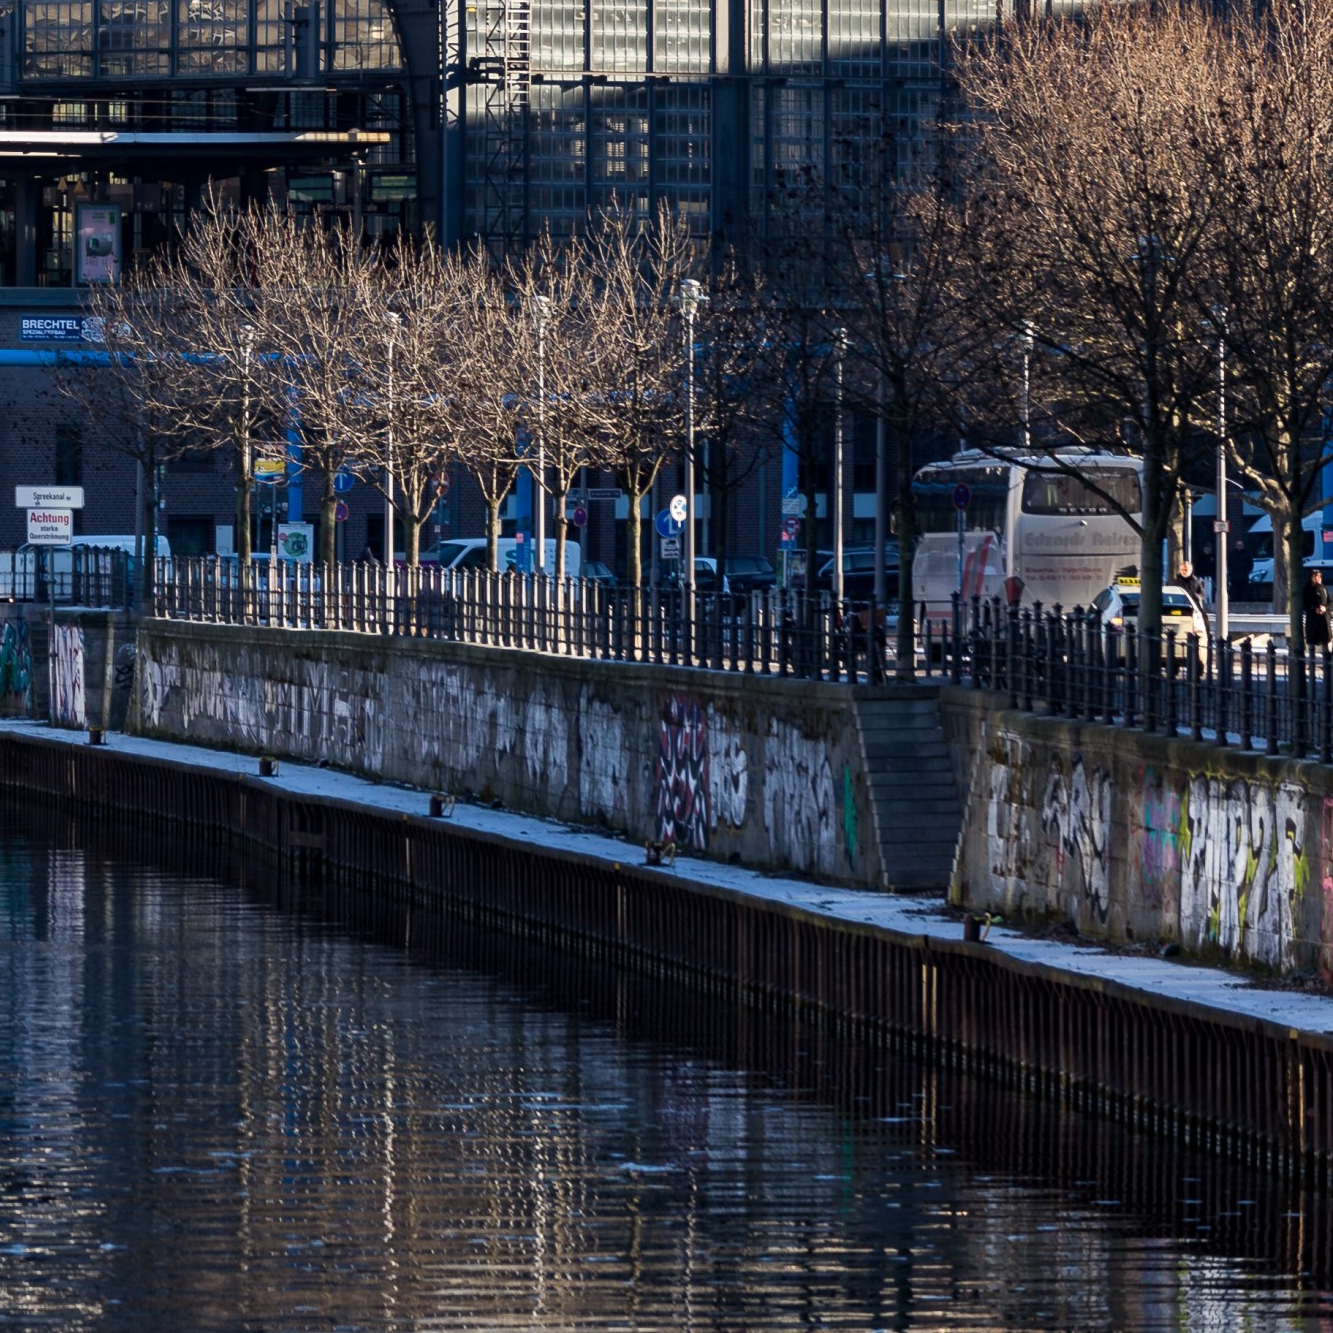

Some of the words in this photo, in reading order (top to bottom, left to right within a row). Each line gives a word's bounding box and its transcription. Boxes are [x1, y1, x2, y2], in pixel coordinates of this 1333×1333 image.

[22, 319, 80, 329] BRECHTEL
[33, 491, 65, 502] Spreekanal
[29, 512, 70, 526] Achtung
